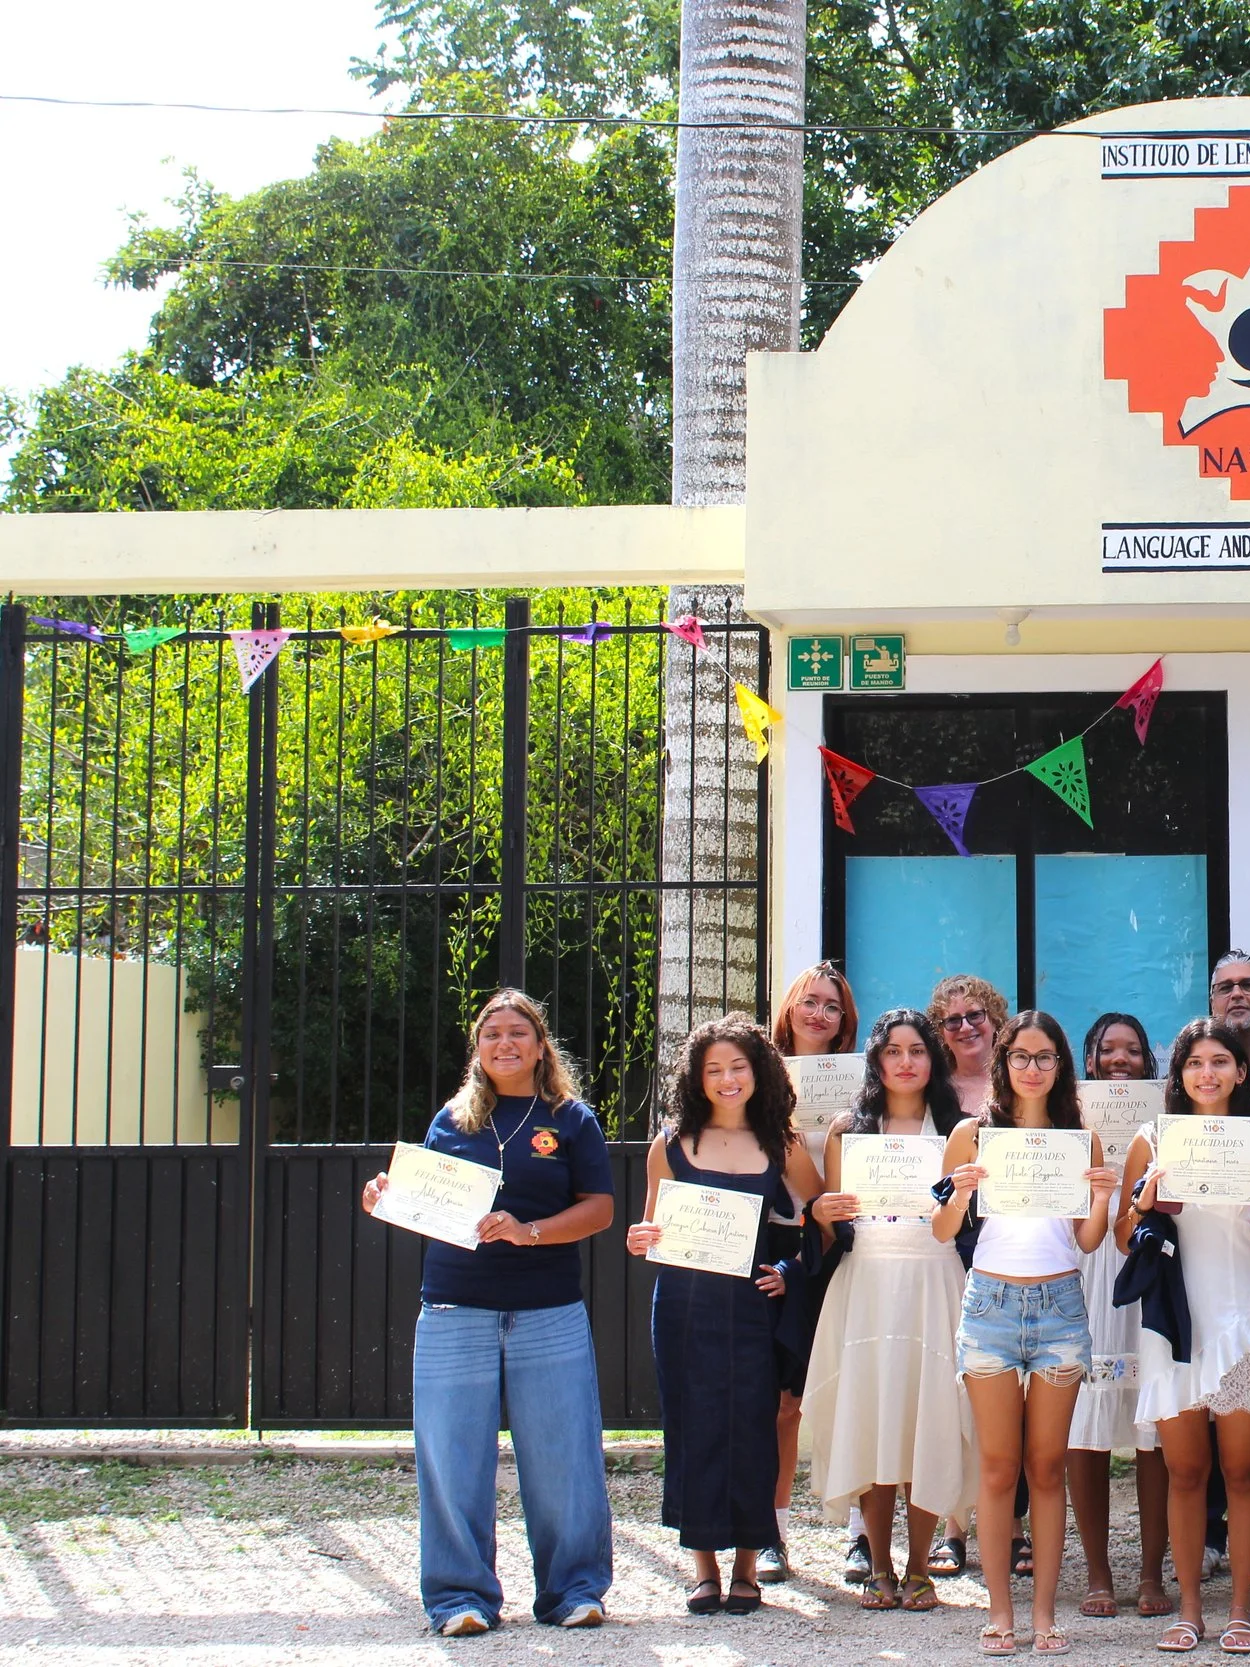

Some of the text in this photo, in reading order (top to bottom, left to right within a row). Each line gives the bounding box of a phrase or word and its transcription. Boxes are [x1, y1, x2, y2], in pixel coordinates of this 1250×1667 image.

[1102, 143, 1189, 168] INSTITUTO
[1198, 143, 1219, 166] DE
[1102, 535, 1211, 559] LANGUAGE
[801, 1073, 855, 1083] FELICIDADES
[1091, 1100, 1148, 1109] FELICIDADES
[1183, 1138, 1244, 1148] FELICIDADES
[866, 1155, 922, 1163] FELICIDADES
[1005, 1152, 1066, 1161] FELICIDADES
[414, 1169, 473, 1193] FELICIDADES
[680, 1204, 736, 1220] FELICIDADES
